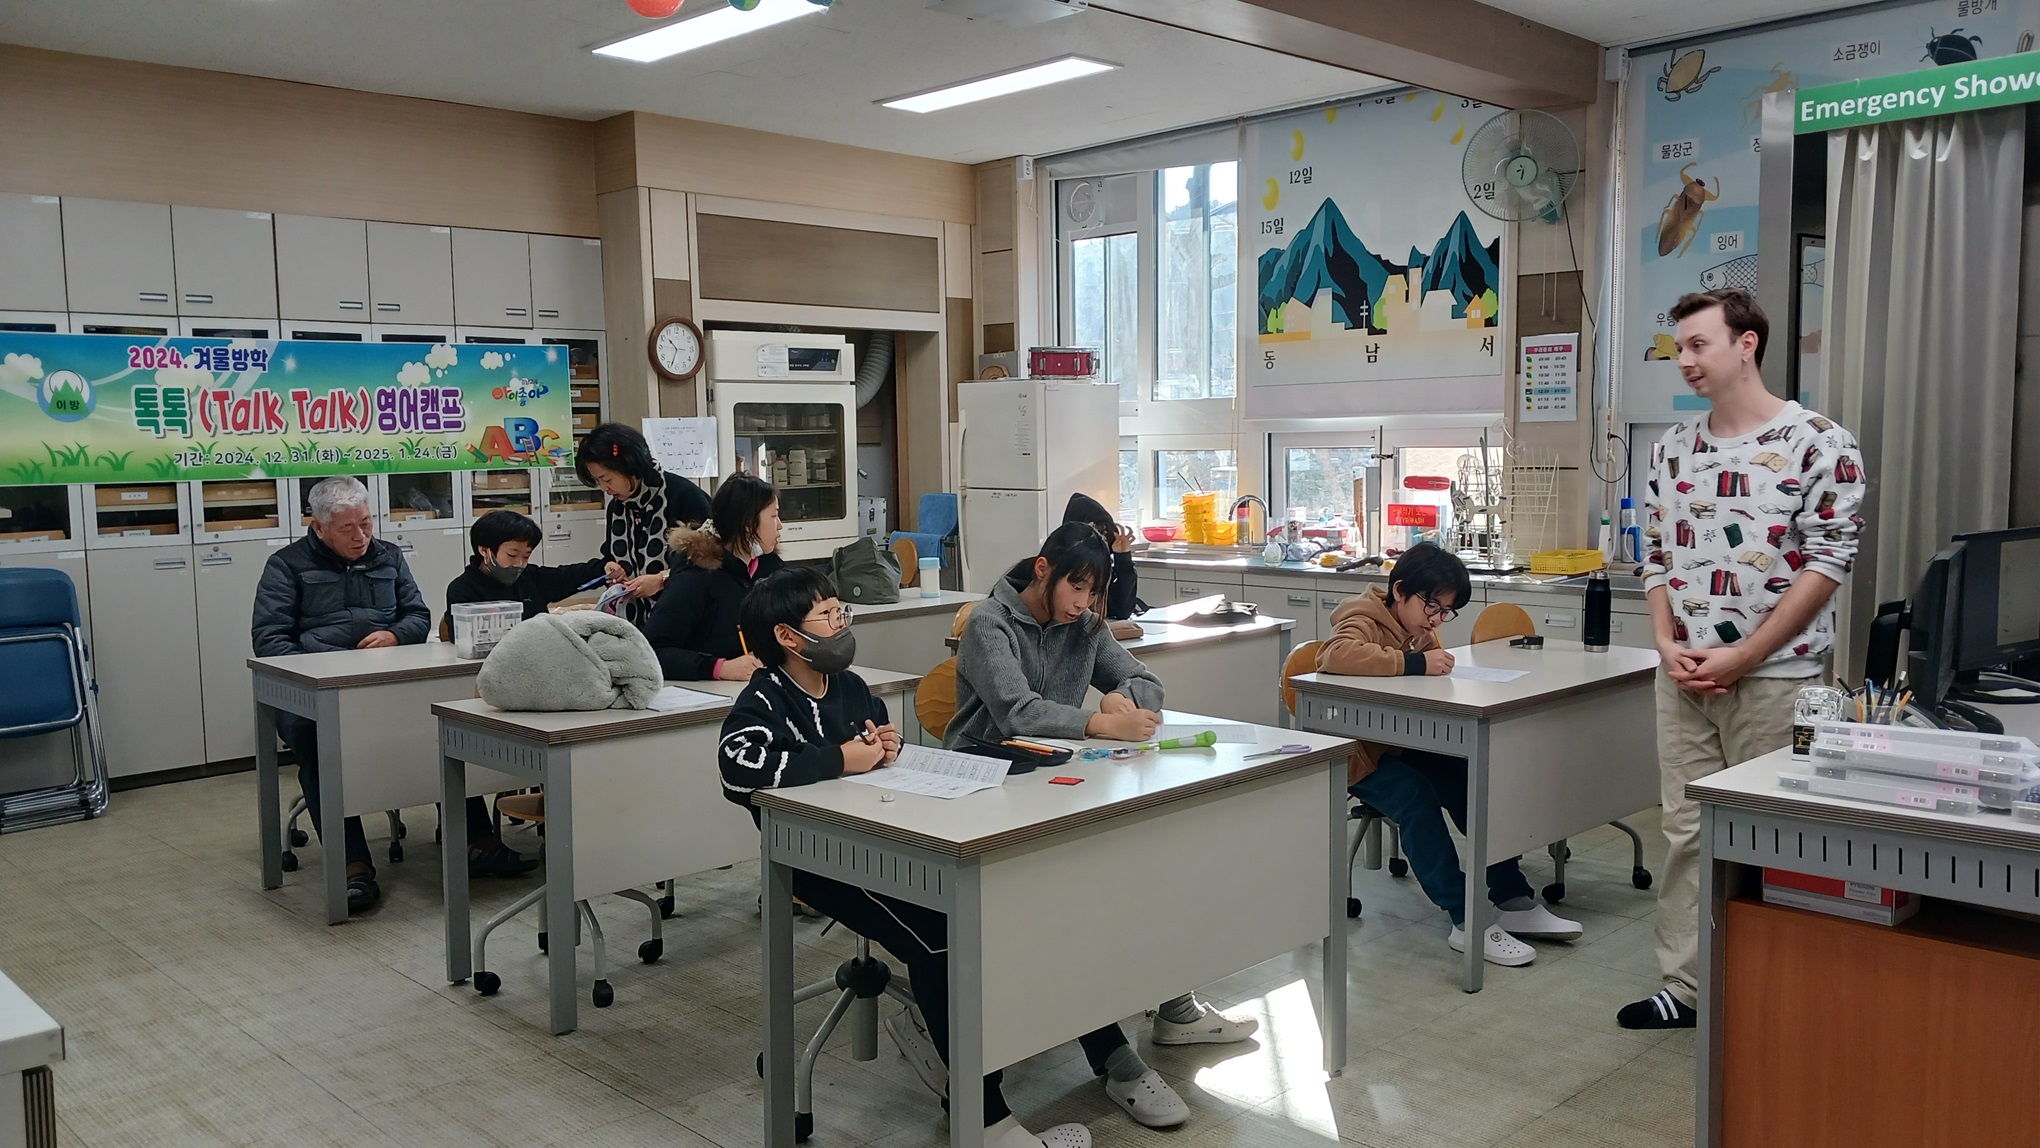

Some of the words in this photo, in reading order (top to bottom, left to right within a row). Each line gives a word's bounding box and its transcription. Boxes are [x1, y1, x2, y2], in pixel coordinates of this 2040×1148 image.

[1832, 40, 1881, 62] 소금쟁이
[1800, 85, 1947, 122] Emergency
[1661, 141, 1693, 159] 물장군
[1289, 166, 1313, 184] 12일
[1473, 182, 1496, 200] 2일
[1261, 217, 1284, 235] 15일
[1717, 233, 1738, 250] 잉어
[1365, 343, 1380, 363] 남
[1480, 335, 1495, 357] 서
[129, 346, 188, 369] 2024.
[194, 347, 268, 371] 겨울방학
[1263, 350, 1276, 369] 동
[134, 387, 188, 435] 톡톡
[200, 389, 284, 433] (Talk
[292, 389, 369, 431] Talk)
[377, 387, 462, 431] 영어캠프
[174, 452, 210, 466] 기간:
[215, 452, 259, 464] 2024.
[265, 451, 287, 463] 12.
[355, 449, 394, 461] 2025.
